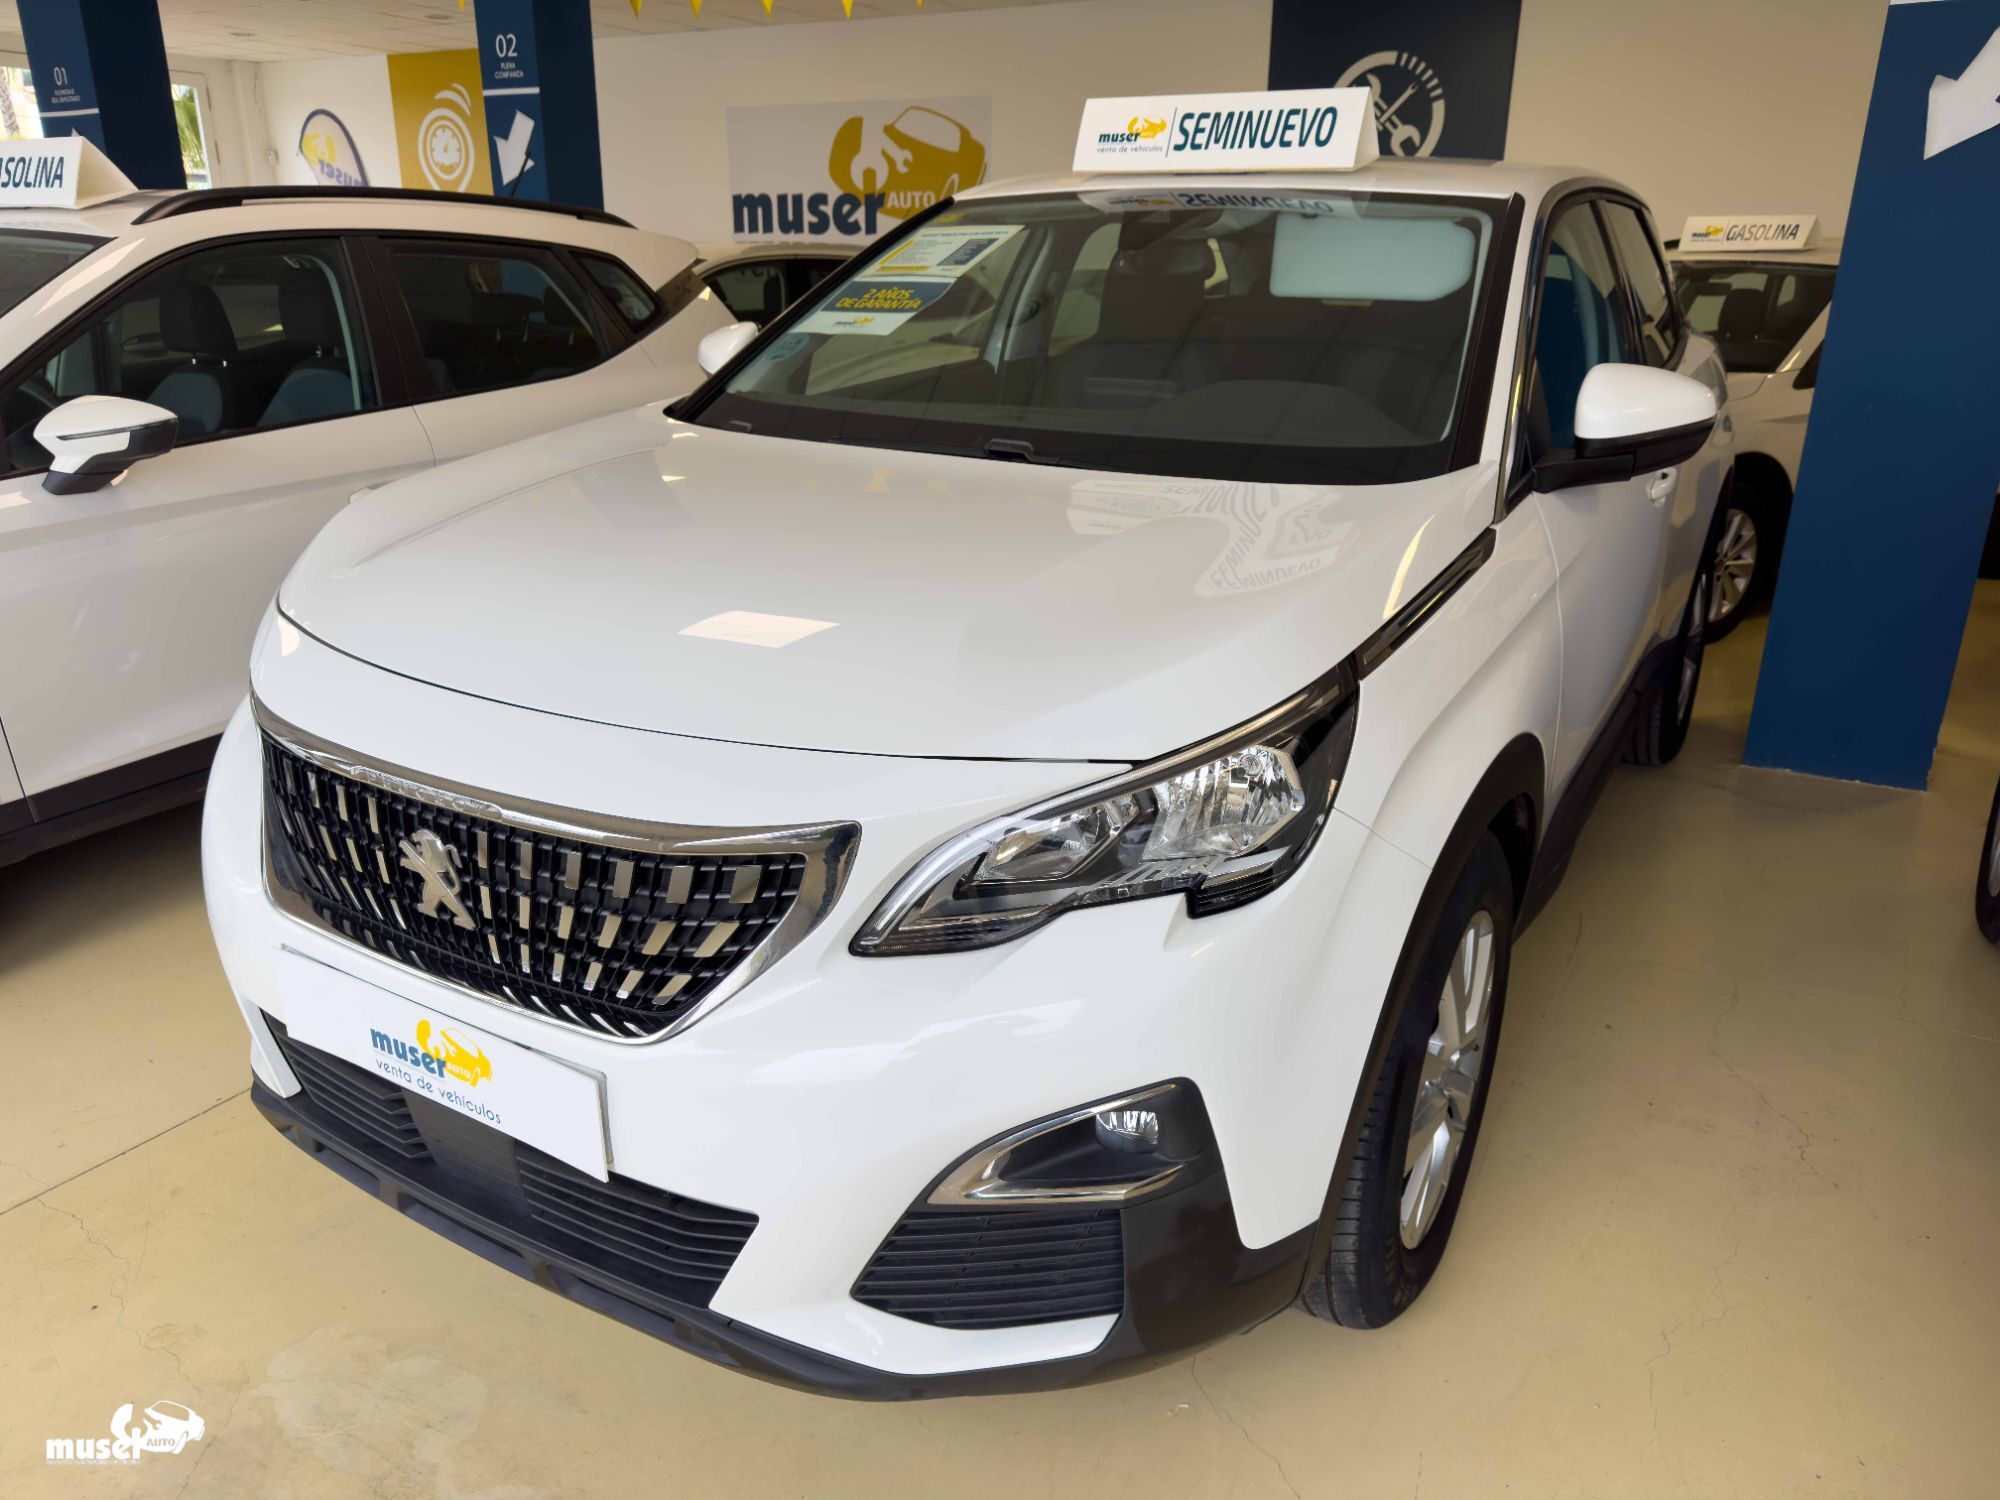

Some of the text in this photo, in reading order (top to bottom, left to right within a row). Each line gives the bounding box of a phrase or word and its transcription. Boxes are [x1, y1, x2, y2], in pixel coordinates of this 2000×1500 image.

[495, 33, 518, 58] 02
[53, 66, 68, 86] 01
[1098, 131, 1141, 143] muser
[1173, 106, 1338, 151] SEMINUEVO
[0, 156, 65, 189] SOLINA
[732, 190, 935, 236] muser AUTO
[1726, 224, 1800, 241] GASOLINA
[370, 1028, 446, 1078] muser
[376, 1058, 412, 1083] venta
[416, 1076, 433, 1093] de
